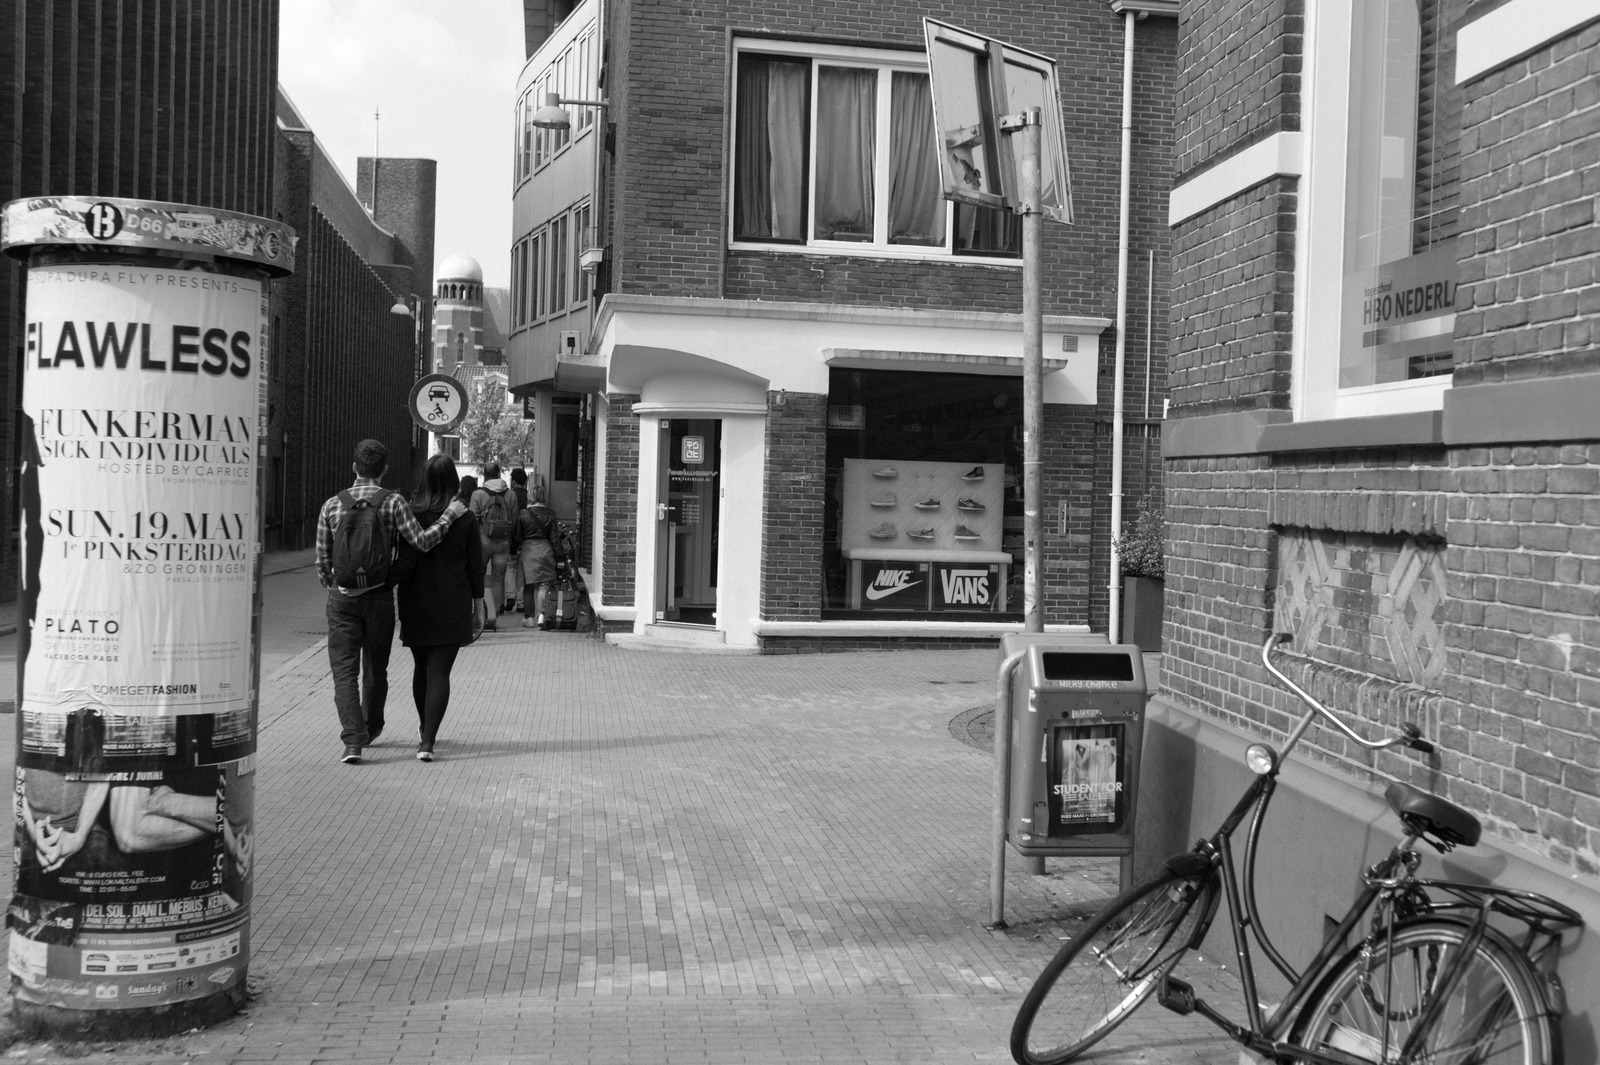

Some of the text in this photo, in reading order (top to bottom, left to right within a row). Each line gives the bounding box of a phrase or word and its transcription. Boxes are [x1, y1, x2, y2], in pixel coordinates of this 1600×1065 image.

[126, 213, 163, 233] D66
[67, 271, 111, 282] DUPA
[117, 272, 149, 284] FLY
[155, 274, 238, 293] PRESENTS
[1363, 294, 1392, 326] HBO
[26, 320, 251, 379] FLAWLESS
[40, 408, 251, 443] FUNKERMAN
[42, 439, 250, 465] SICK INDIVIDUALS
[98, 463, 249, 478] HOSTED BY CAPRICE
[84, 541, 246, 561] PINKSTERDAG
[163, 564, 246, 574] GRONINGEN
[874, 569, 911, 587] NIKE
[940, 568, 990, 605] VANS
[45, 618, 119, 634] PLATO
[45, 653, 90, 661] FACEBOOK
[93, 644, 119, 653] OUR
[1053, 781, 1123, 795] STUDENT FOR
[133, 903, 157, 917] DANI
